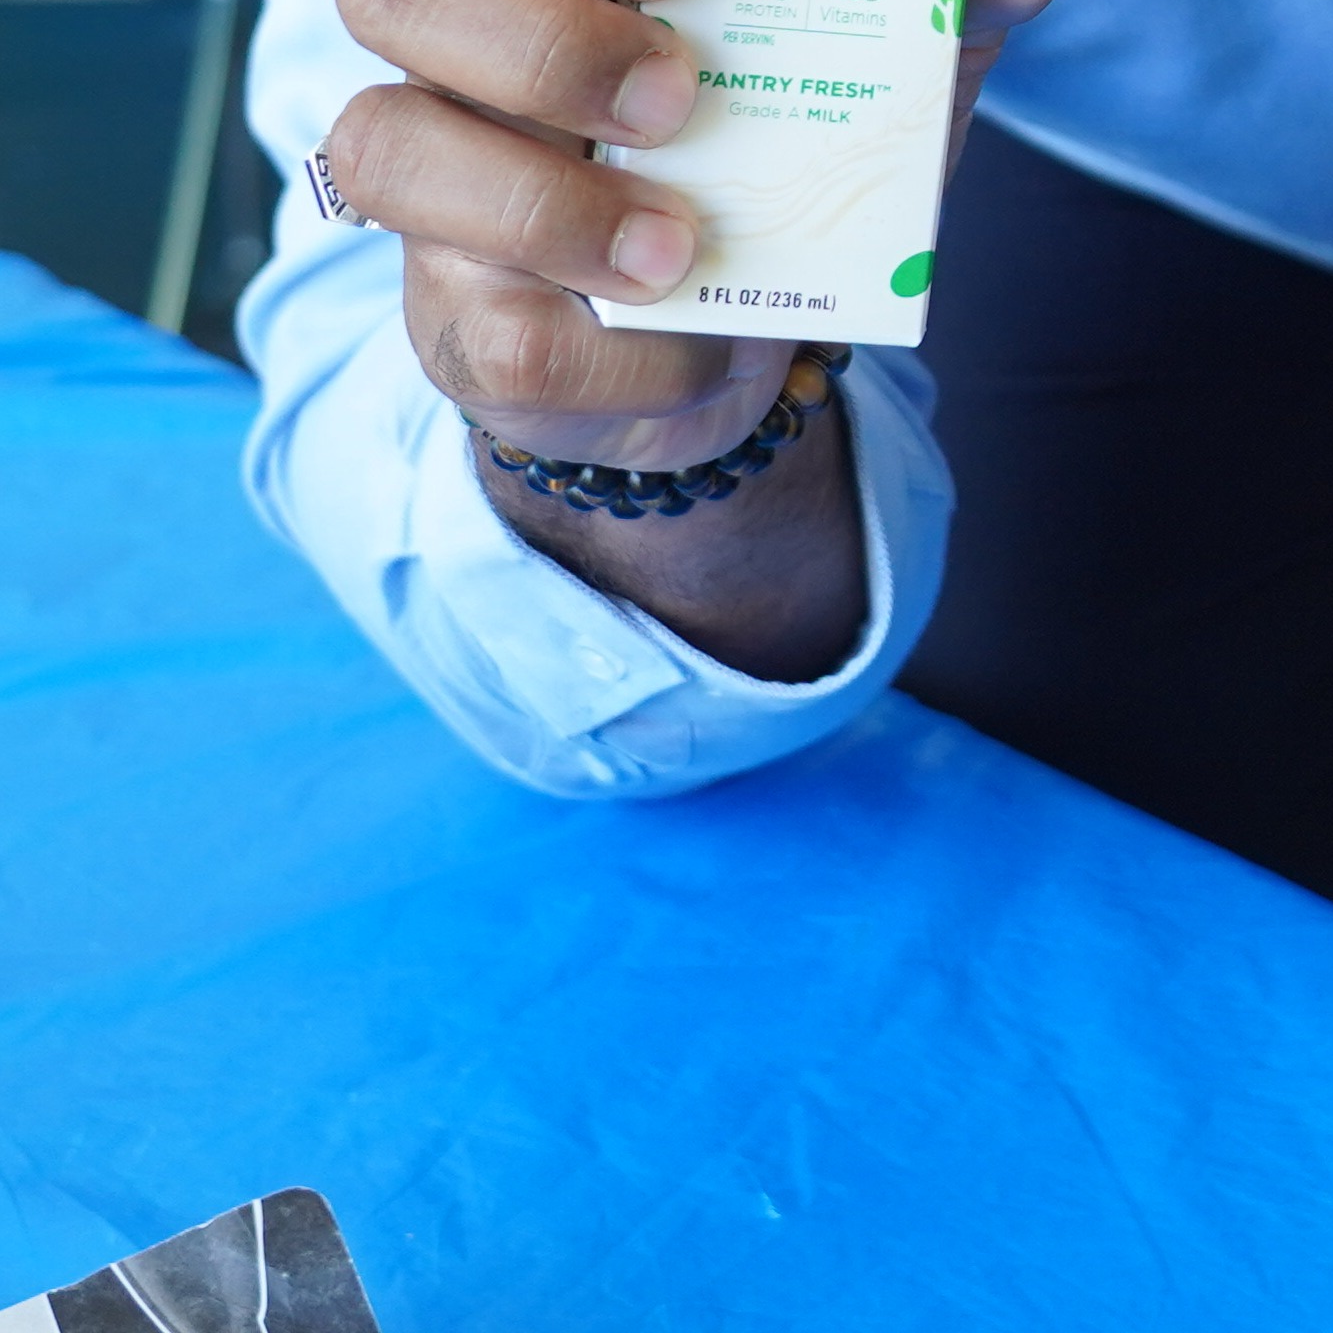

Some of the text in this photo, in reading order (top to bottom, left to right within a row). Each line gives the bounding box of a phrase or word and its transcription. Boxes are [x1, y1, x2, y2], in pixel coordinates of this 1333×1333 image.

[735, 3, 797, 19] PROTEIN
[820, 5, 887, 28] Vitamins
[723, 30, 777, 46] PER SERVING
[698, 71, 794, 93] PANTRY
[729, 101, 852, 123] Grade A MILK
[699, 286, 837, 312] 8 FL OZ (236 mL)
